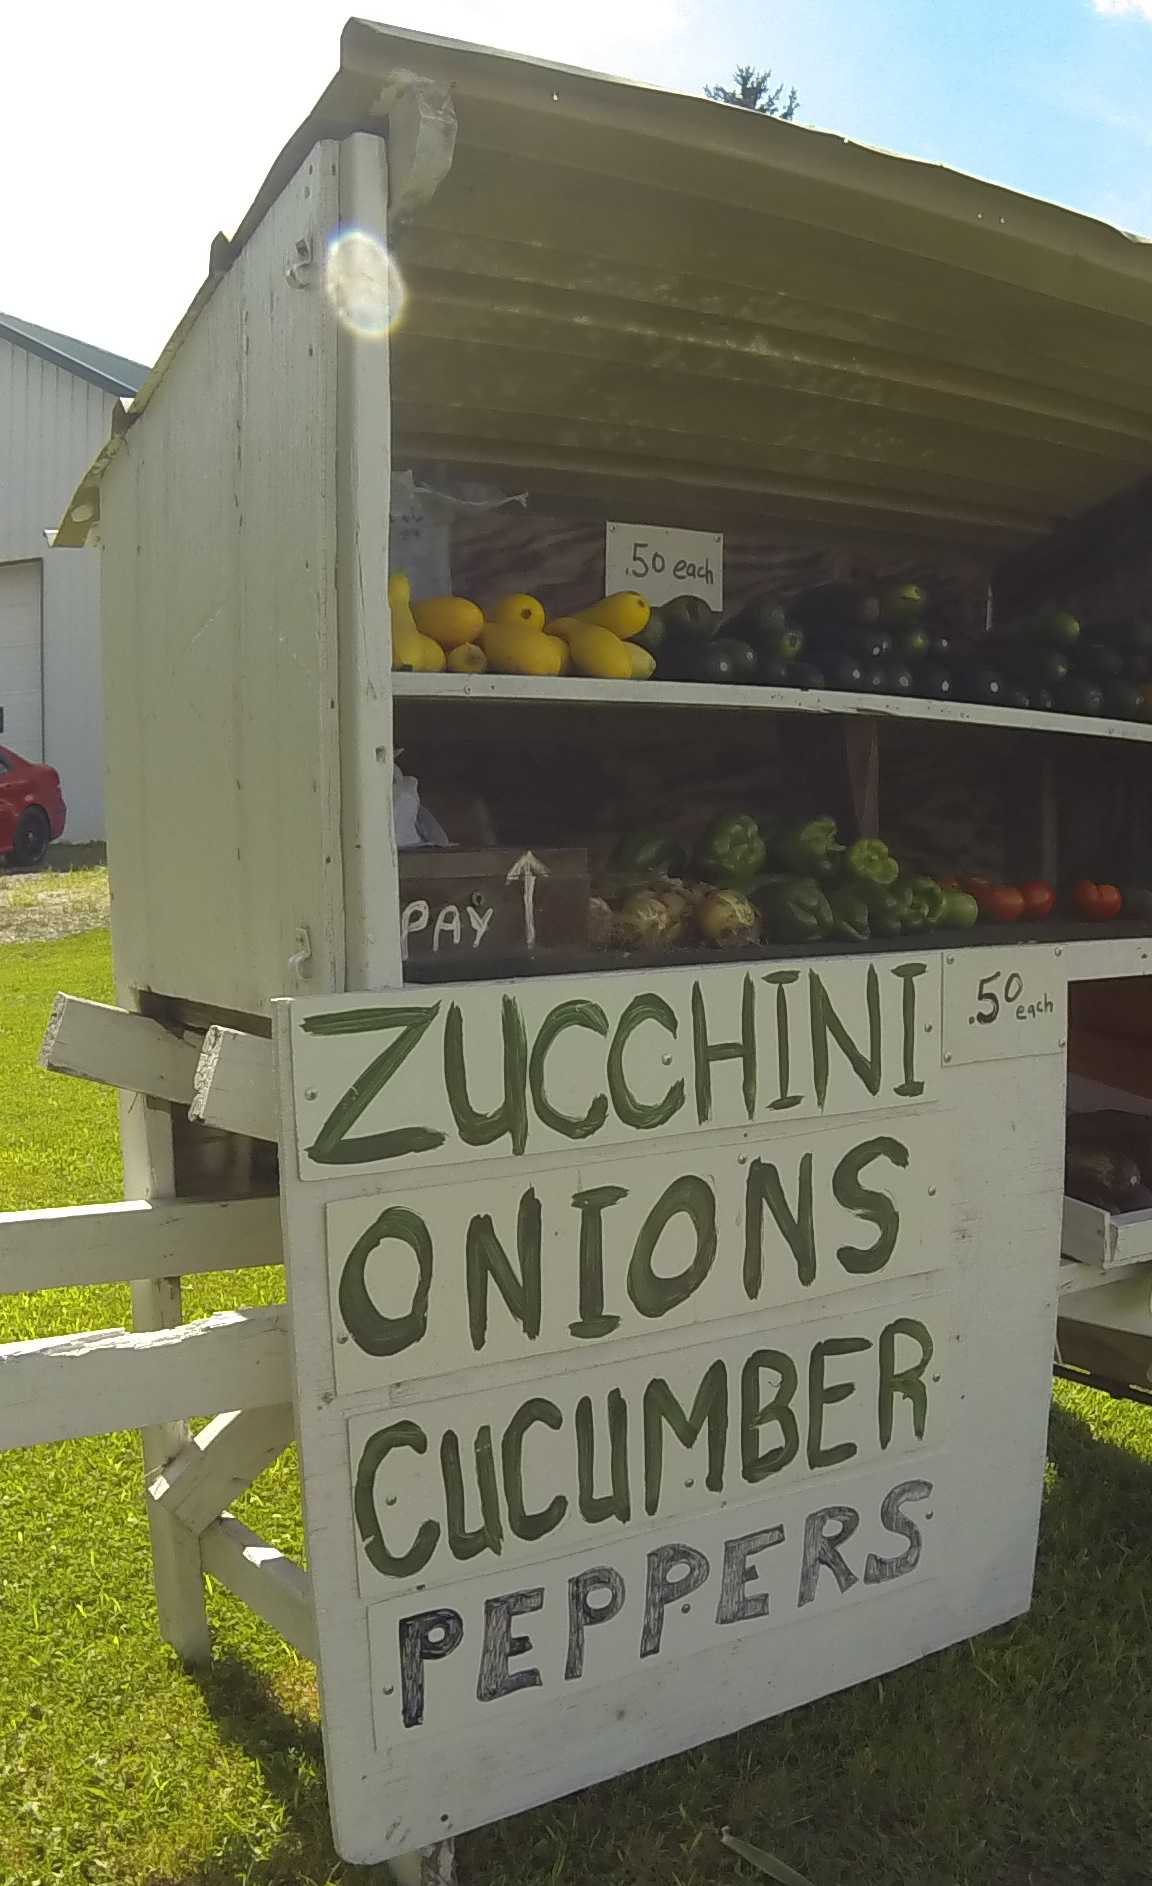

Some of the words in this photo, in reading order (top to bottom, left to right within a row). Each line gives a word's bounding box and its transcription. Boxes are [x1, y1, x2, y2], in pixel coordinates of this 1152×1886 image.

[624, 542, 666, 579] .50
[672, 556, 715, 586] each
[401, 899, 494, 961] PAY
[968, 970, 1023, 1025] .50
[1015, 992, 1055, 1020] each
[300, 962, 928, 1165] ZUCCHINI
[338, 1135, 910, 1357] ONIONS
[354, 1317, 933, 1578] CUCUMBER
[399, 1478, 934, 1729] PEPPERS
